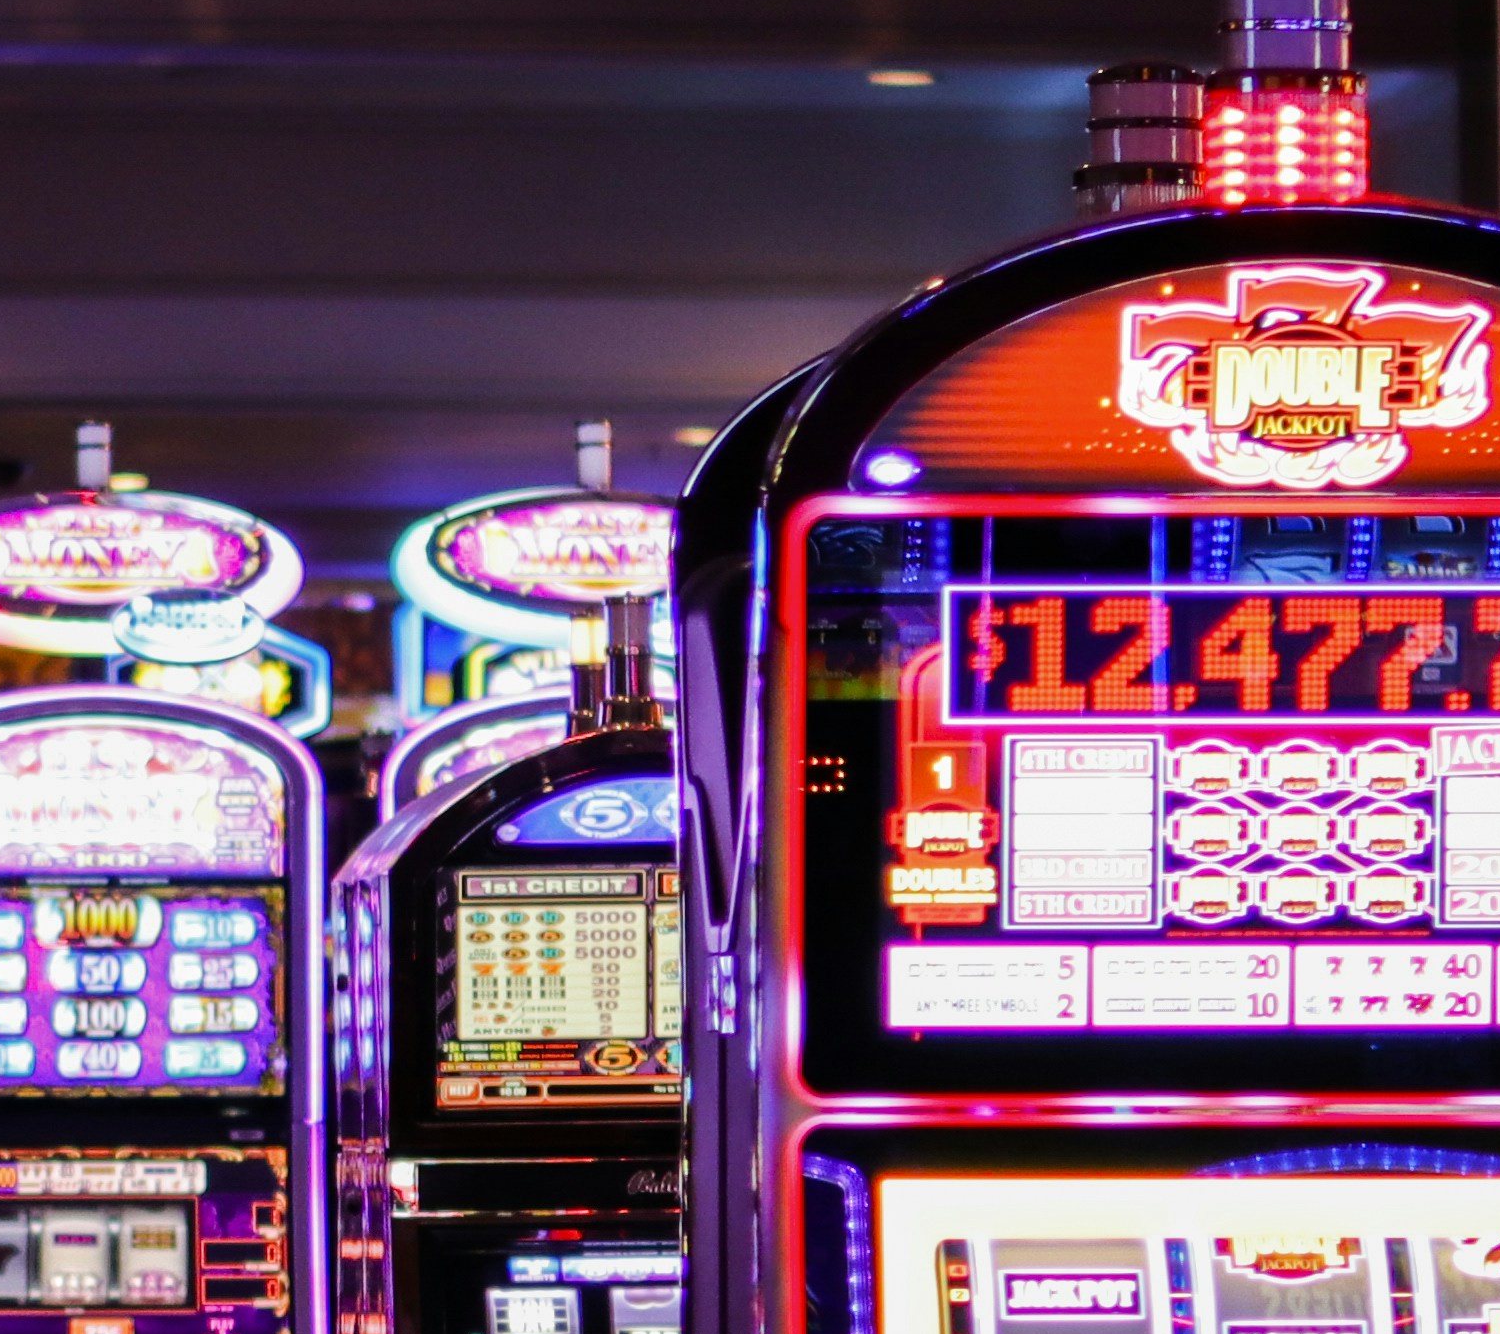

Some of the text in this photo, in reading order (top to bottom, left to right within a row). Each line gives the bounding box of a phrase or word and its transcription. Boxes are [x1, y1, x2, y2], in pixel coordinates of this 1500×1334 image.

[1212, 346, 1394, 428] DOUBLE
[1252, 414, 1349, 439] JACKPOT
[4, 530, 188, 579] MONEY
[931, 755, 953, 790] 1
[1068, 748, 1149, 771] CREDIT
[578, 799, 628, 829] 5
[480, 879, 628, 894] 1st CREDIT
[890, 867, 996, 891] DOUBLES
[1019, 893, 1066, 916] 5TH
[1067, 893, 1147, 917] CREDIT
[60, 899, 138, 940] 1000
[81, 955, 120, 986] 50
[1056, 954, 1076, 980] 5
[1245, 953, 1281, 980] 20
[1442, 953, 1483, 979] 40
[75, 1000, 126, 1030] 100
[1056, 993, 1076, 1019] 2
[1246, 992, 1280, 1018] 10
[1443, 992, 1482, 1017] 20
[81, 1041, 120, 1071] 40
[598, 1046, 635, 1067] 5
[1260, 1257, 1320, 1272] JACKPOT
[1008, 1279, 1136, 1309] JACKPOT
